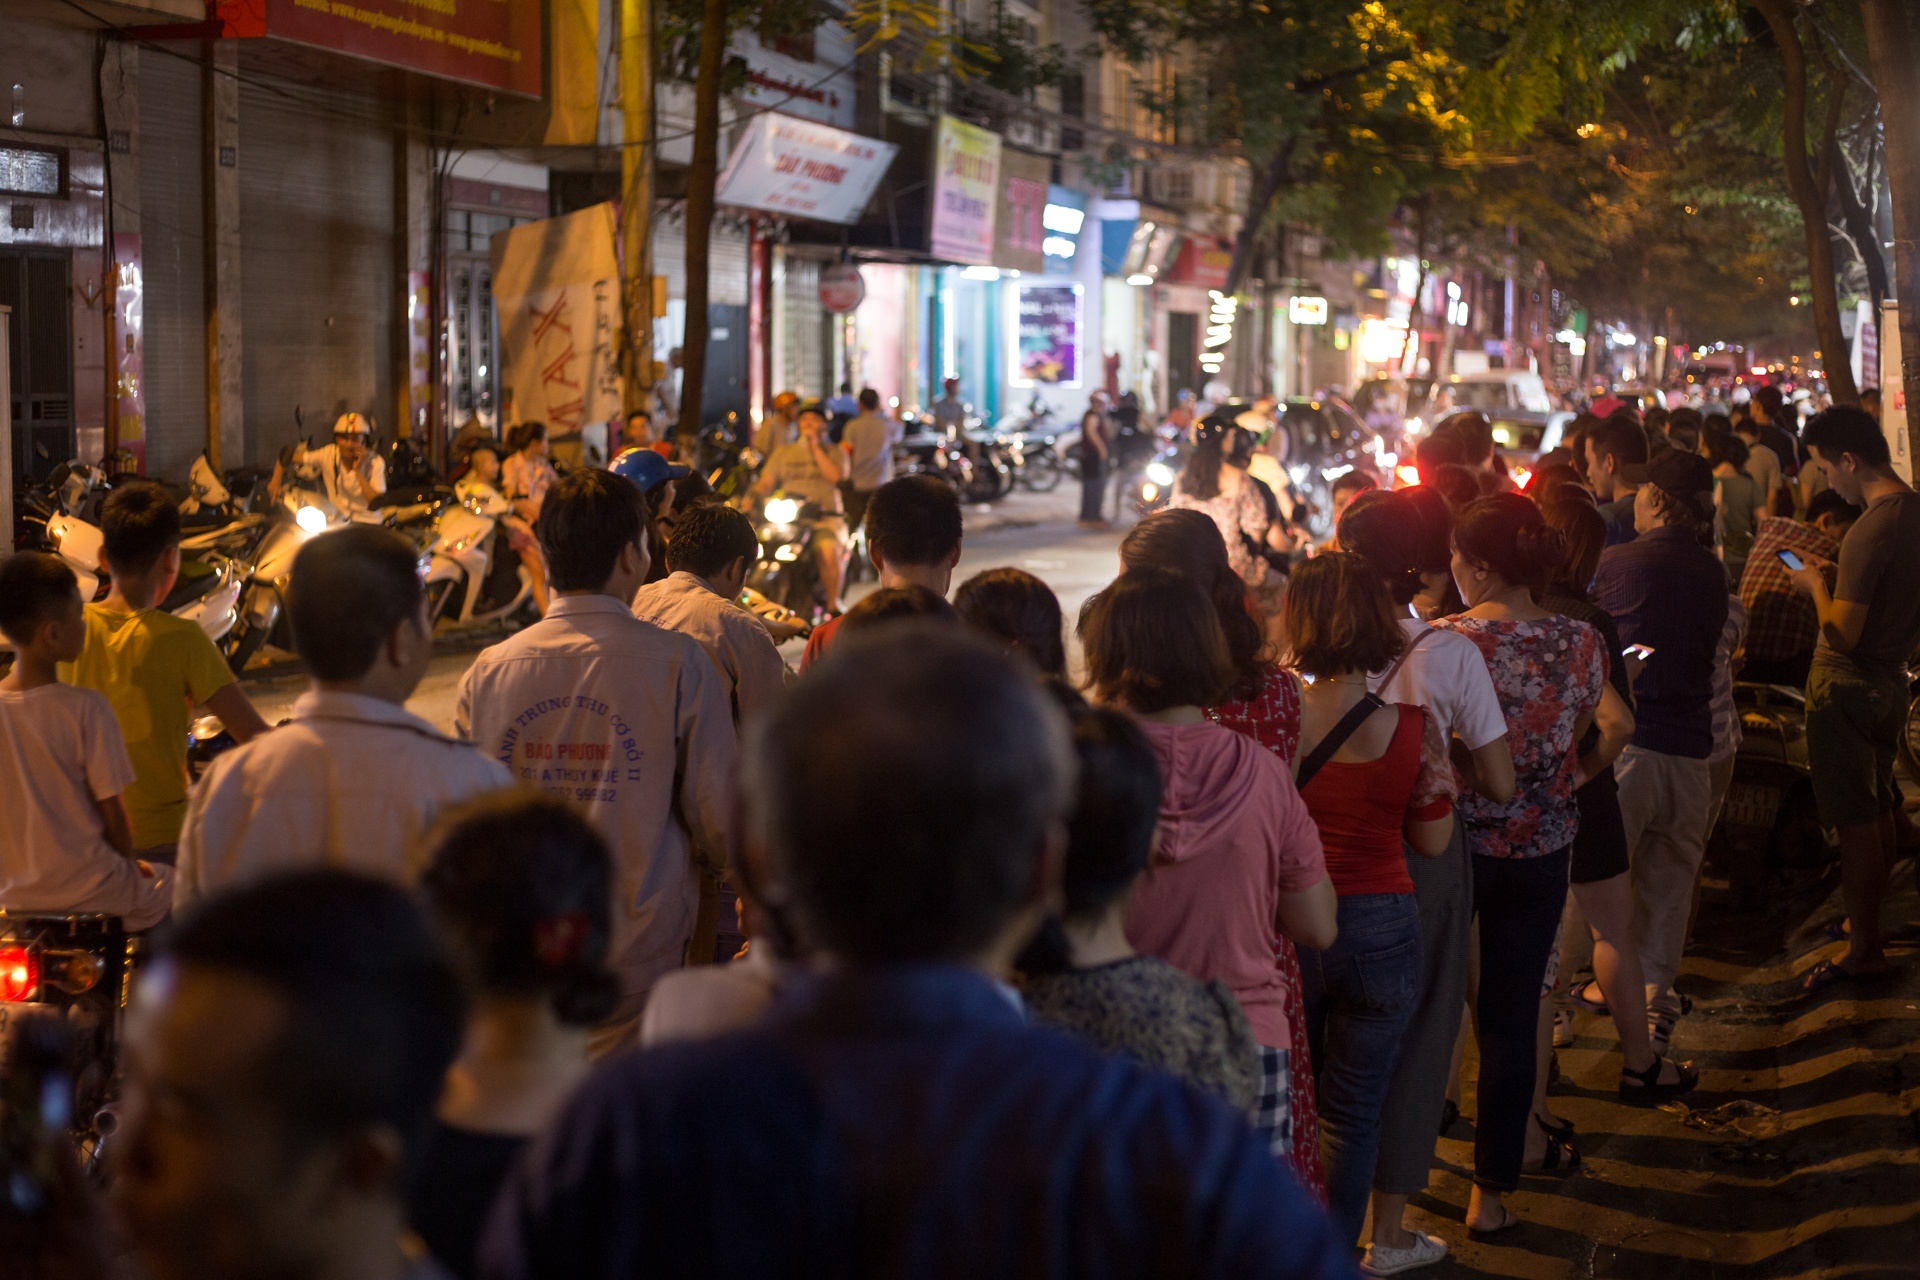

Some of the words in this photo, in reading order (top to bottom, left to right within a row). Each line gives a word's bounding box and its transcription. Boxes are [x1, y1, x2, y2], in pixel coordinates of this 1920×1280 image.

[515, 696, 571, 727] TRUNG
[576, 696, 609, 716] THU
[525, 736, 552, 760] BẢO
[557, 743, 611, 761] PHƯƠNG
[542, 769, 552, 781] A
